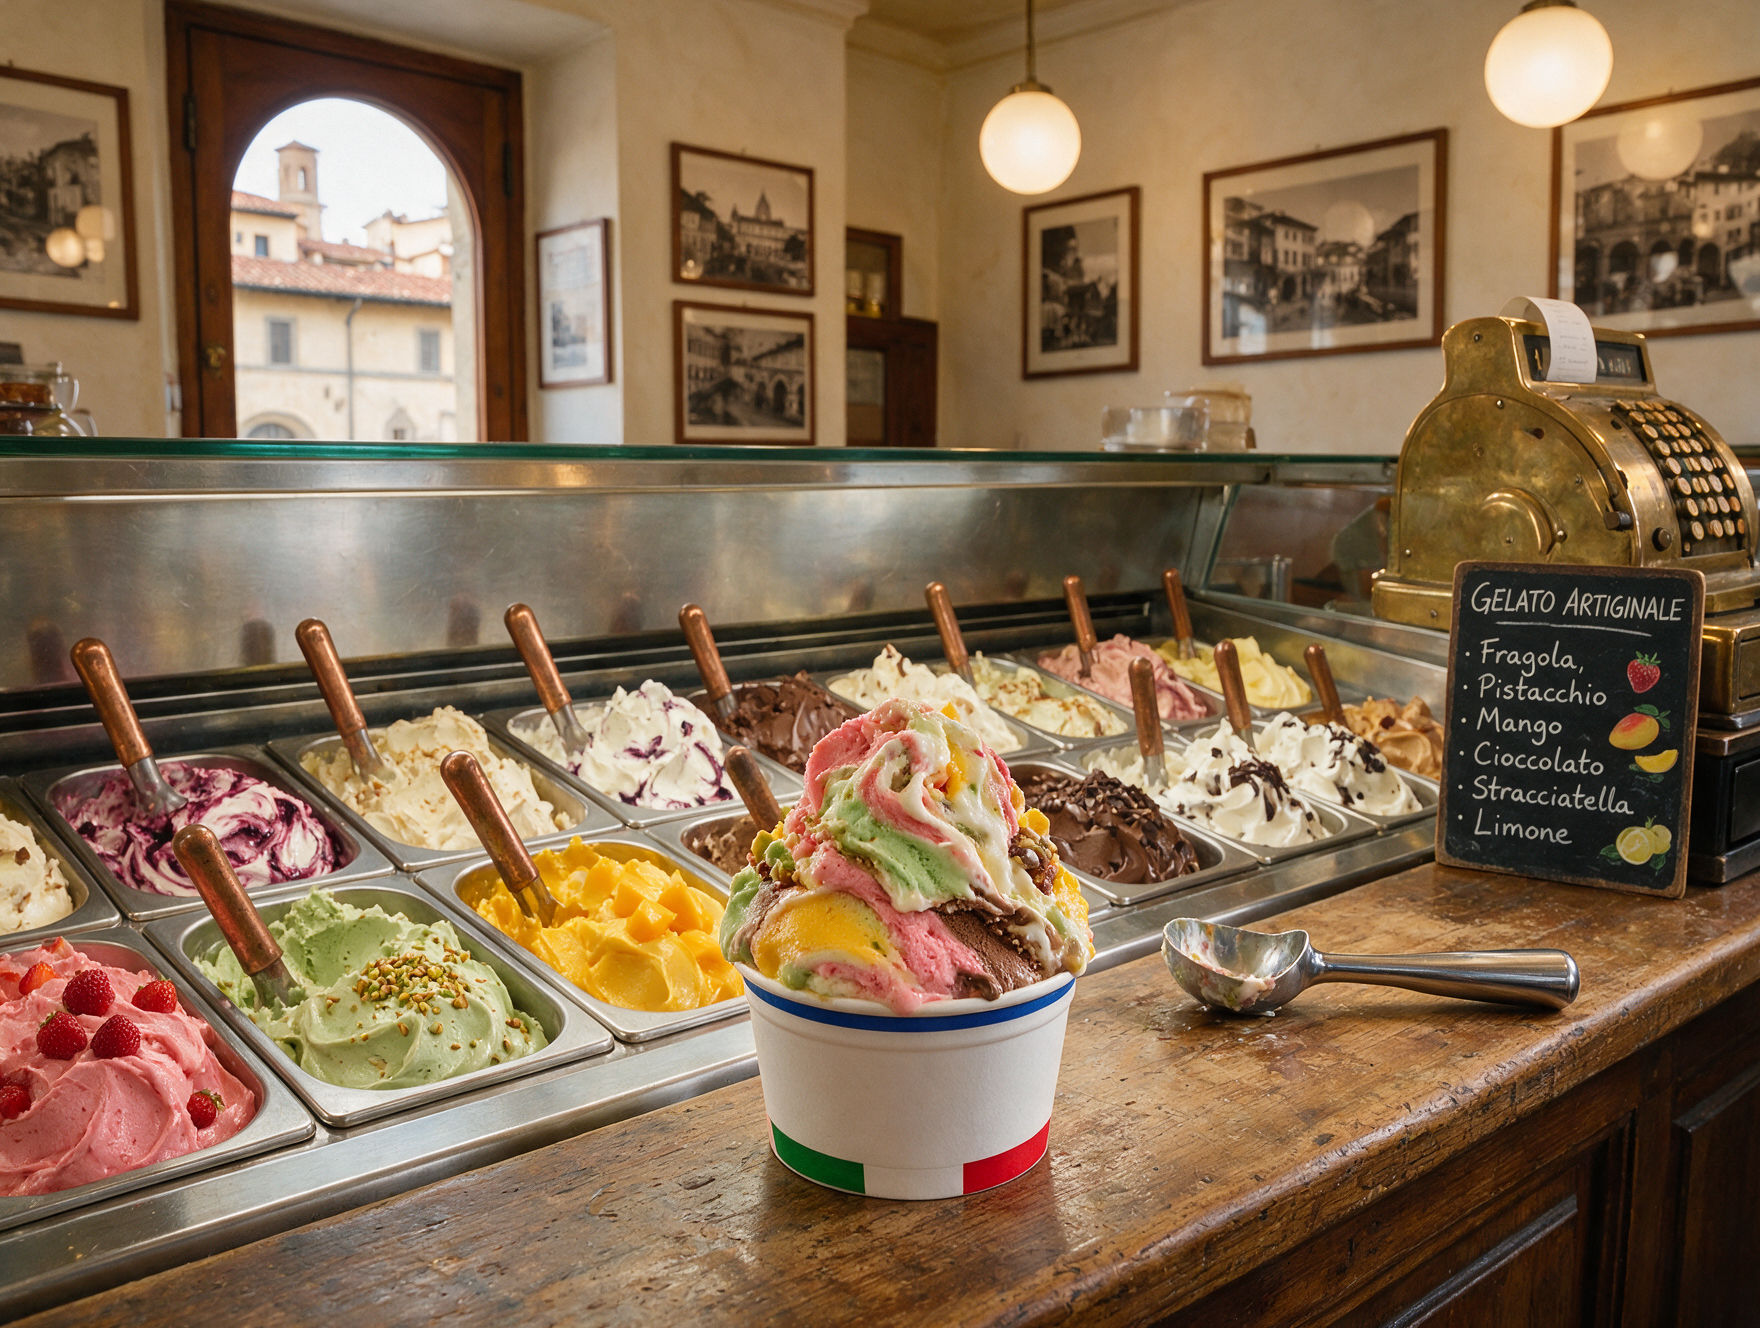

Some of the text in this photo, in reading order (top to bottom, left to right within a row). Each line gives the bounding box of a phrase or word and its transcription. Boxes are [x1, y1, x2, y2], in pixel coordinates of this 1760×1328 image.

[1471, 582, 1685, 621] GELATO ARTIGINALE
[1480, 638, 1584, 677] Fragola,
[1477, 673, 1607, 706] Pistacchio
[1476, 706, 1563, 745] Mango
[1473, 741, 1604, 776] Cioccolato
[1472, 775, 1635, 815] Stracciatella
[1473, 808, 1573, 845] Limone
